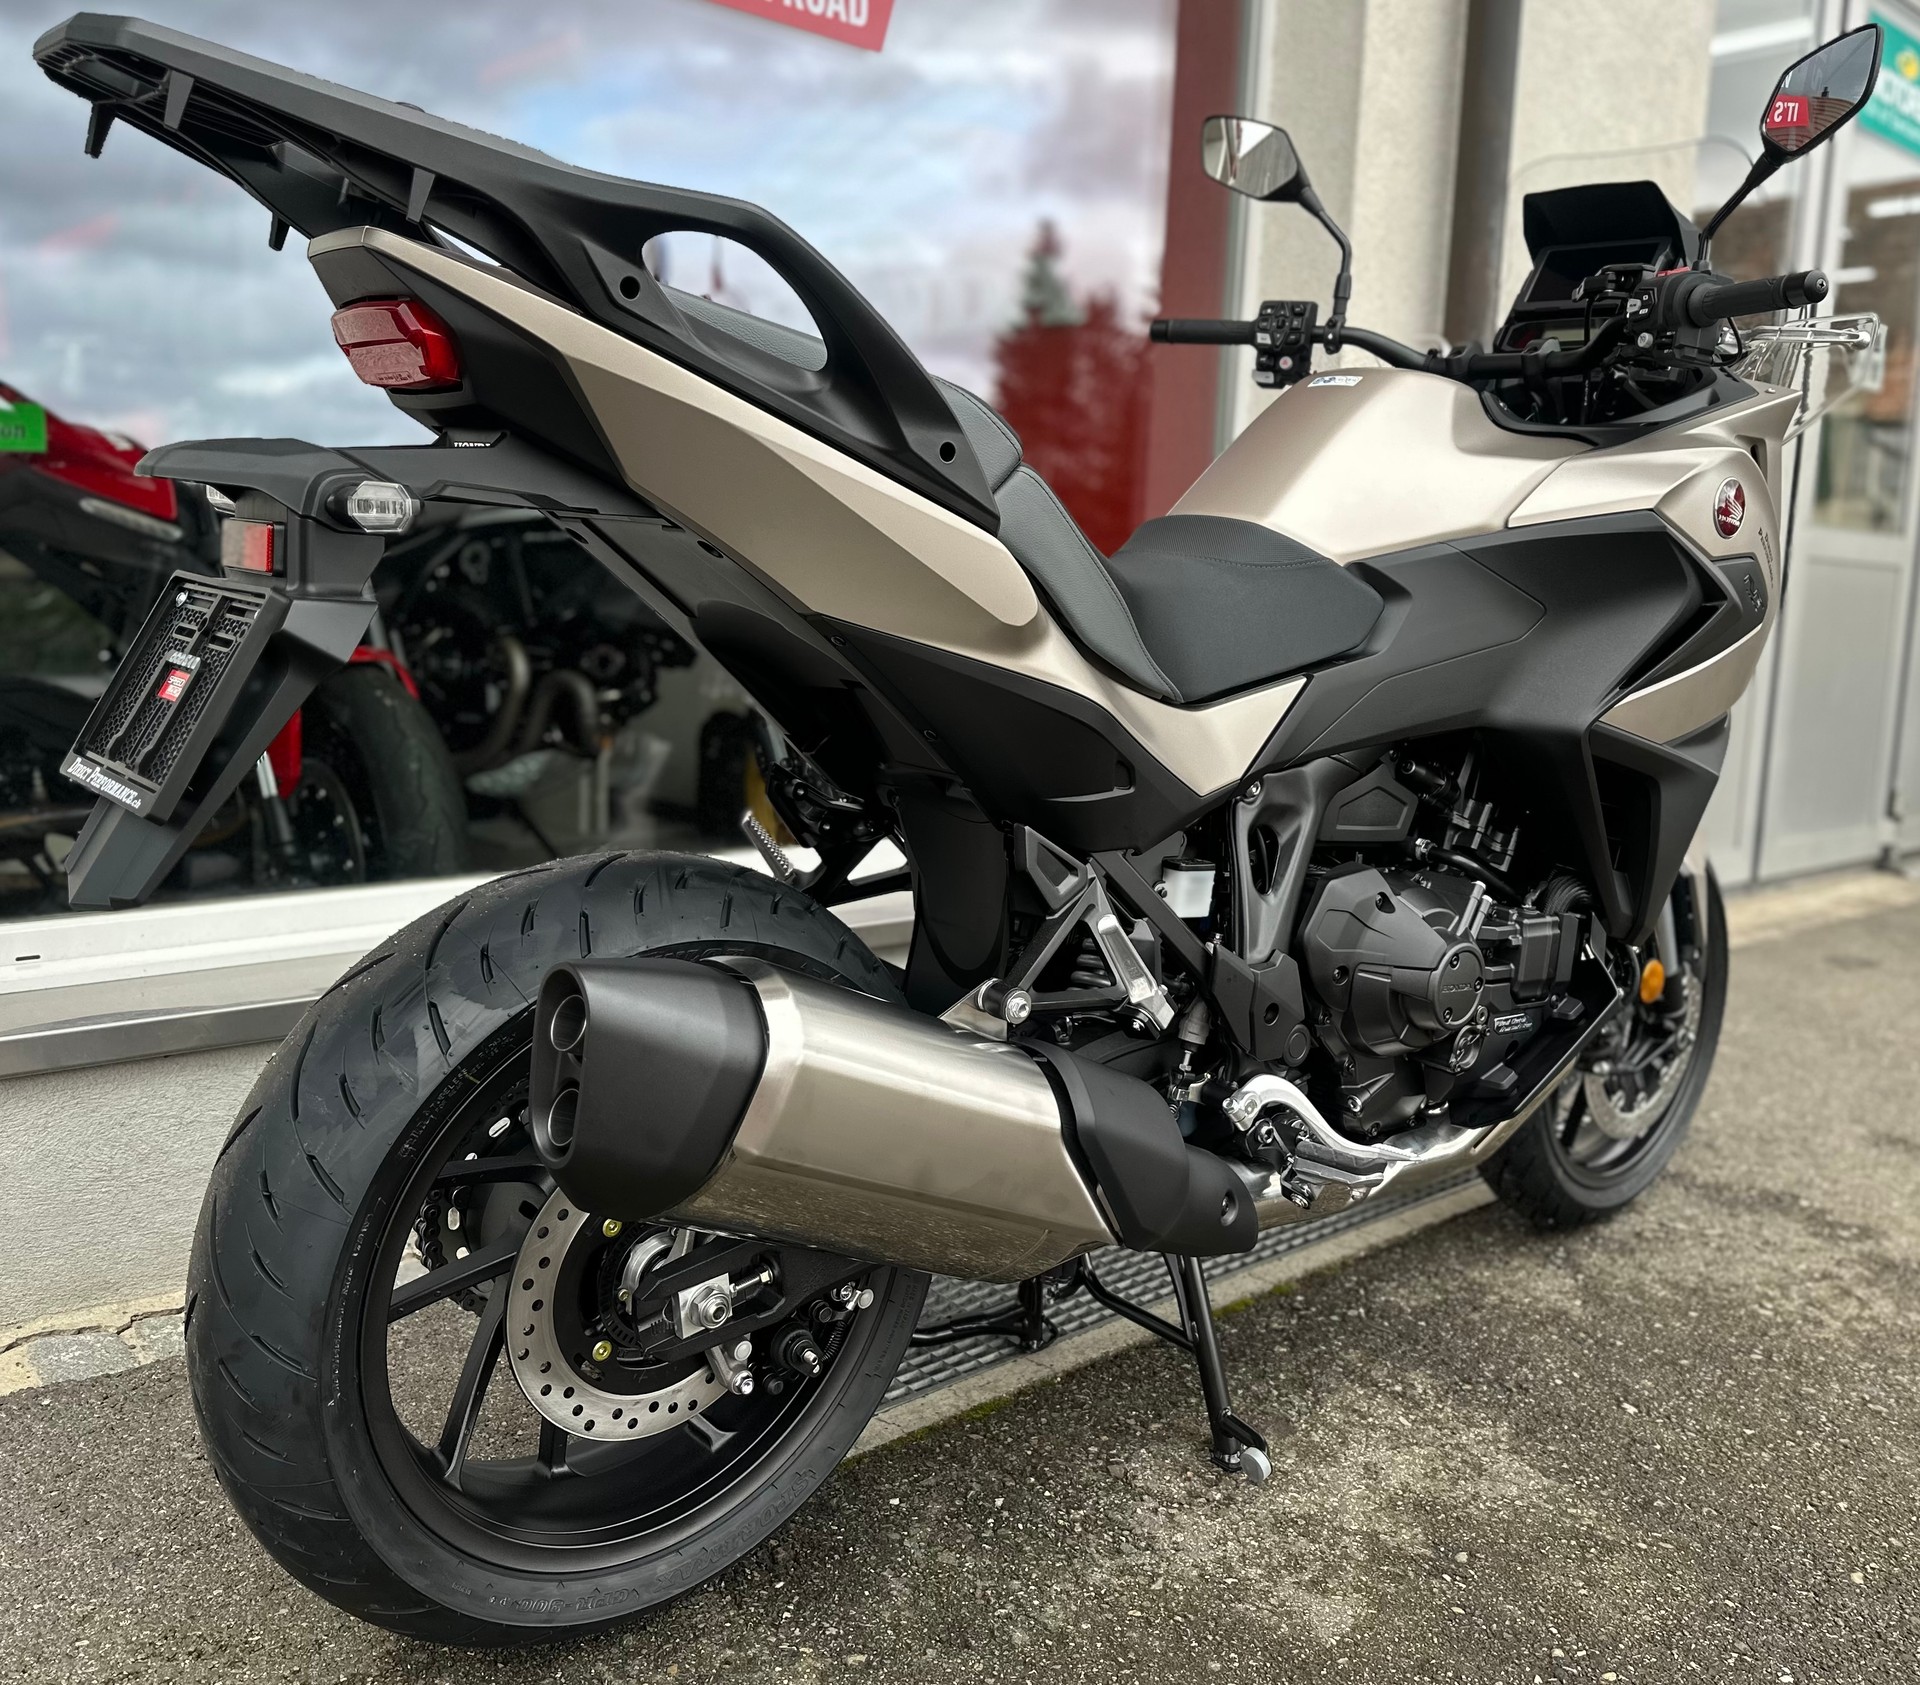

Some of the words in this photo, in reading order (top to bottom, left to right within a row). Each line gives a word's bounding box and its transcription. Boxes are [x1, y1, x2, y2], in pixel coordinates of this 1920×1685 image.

[782, 0, 869, 27] AD
[67, 757, 93, 780] DIRECT
[1441, 983, 1473, 993] HONDA
